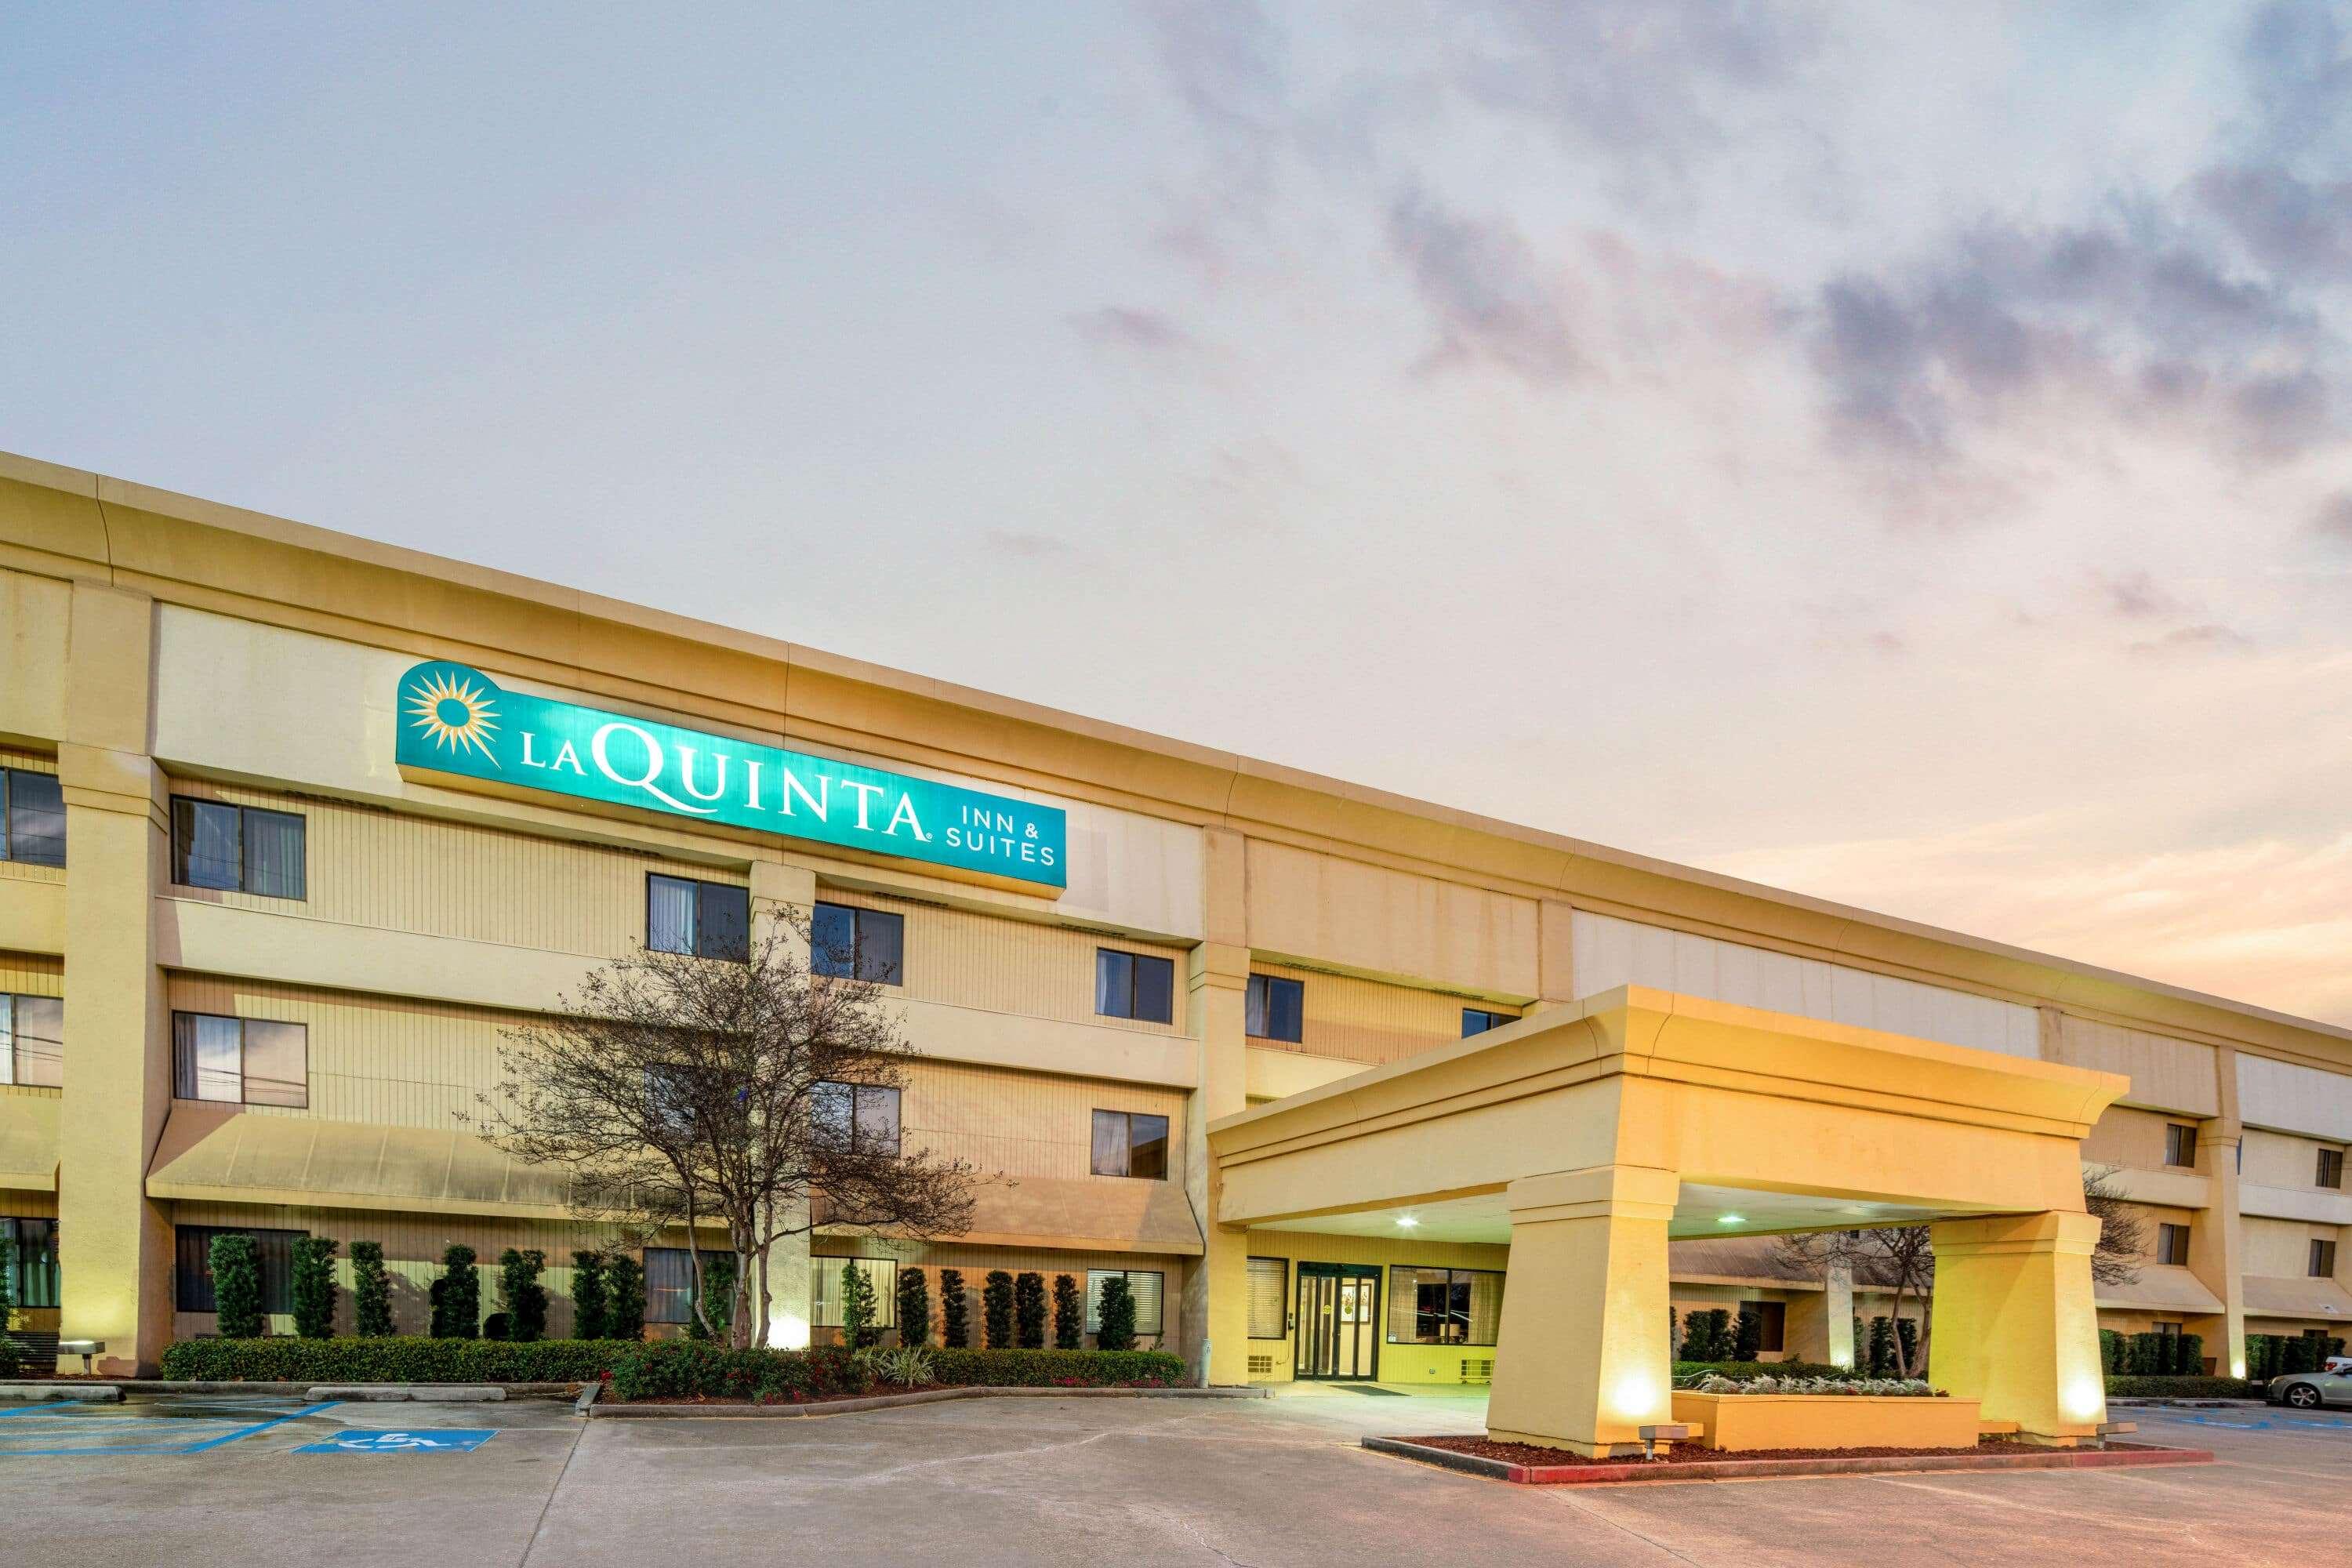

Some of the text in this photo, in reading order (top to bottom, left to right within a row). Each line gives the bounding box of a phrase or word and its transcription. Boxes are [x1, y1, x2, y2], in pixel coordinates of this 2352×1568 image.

[519, 722, 931, 843] LA QUINTA
[962, 805, 1039, 840] INN &
[946, 827, 1054, 866] SUITES
